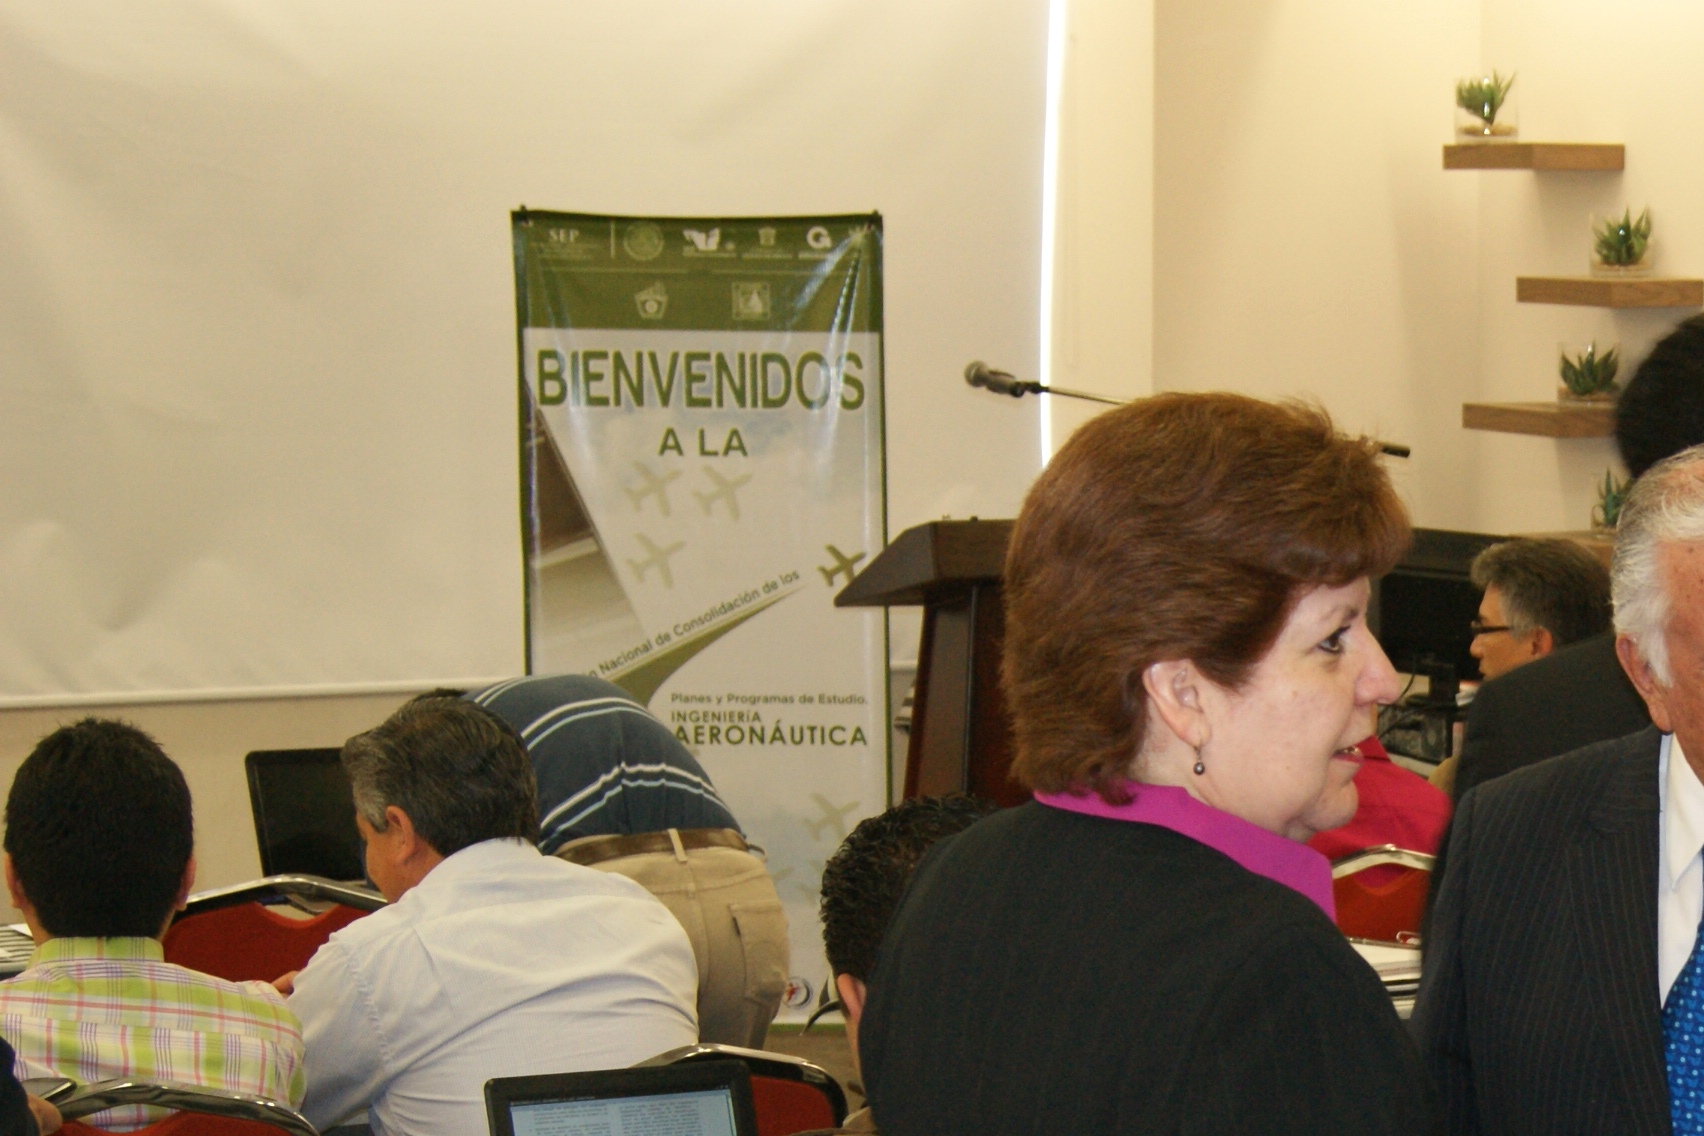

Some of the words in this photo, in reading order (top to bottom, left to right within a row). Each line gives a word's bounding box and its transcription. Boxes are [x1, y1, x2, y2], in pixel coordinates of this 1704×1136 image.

[536, 348, 866, 411] BIENVENIDOS
[658, 428, 684, 457] A
[699, 428, 748, 458] LA
[598, 639, 653, 675] Nacional
[655, 632, 672, 646] de
[673, 588, 761, 638] Consolidación
[762, 580, 779, 594] de
[779, 568, 800, 586] los
[671, 693, 712, 704] Planes
[716, 695, 722, 705] y
[727, 693, 795, 706] Programas
[799, 693, 814, 704] de
[671, 709, 762, 723] INGENIERÍA
[674, 718, 867, 746] AERONÁUTICA
